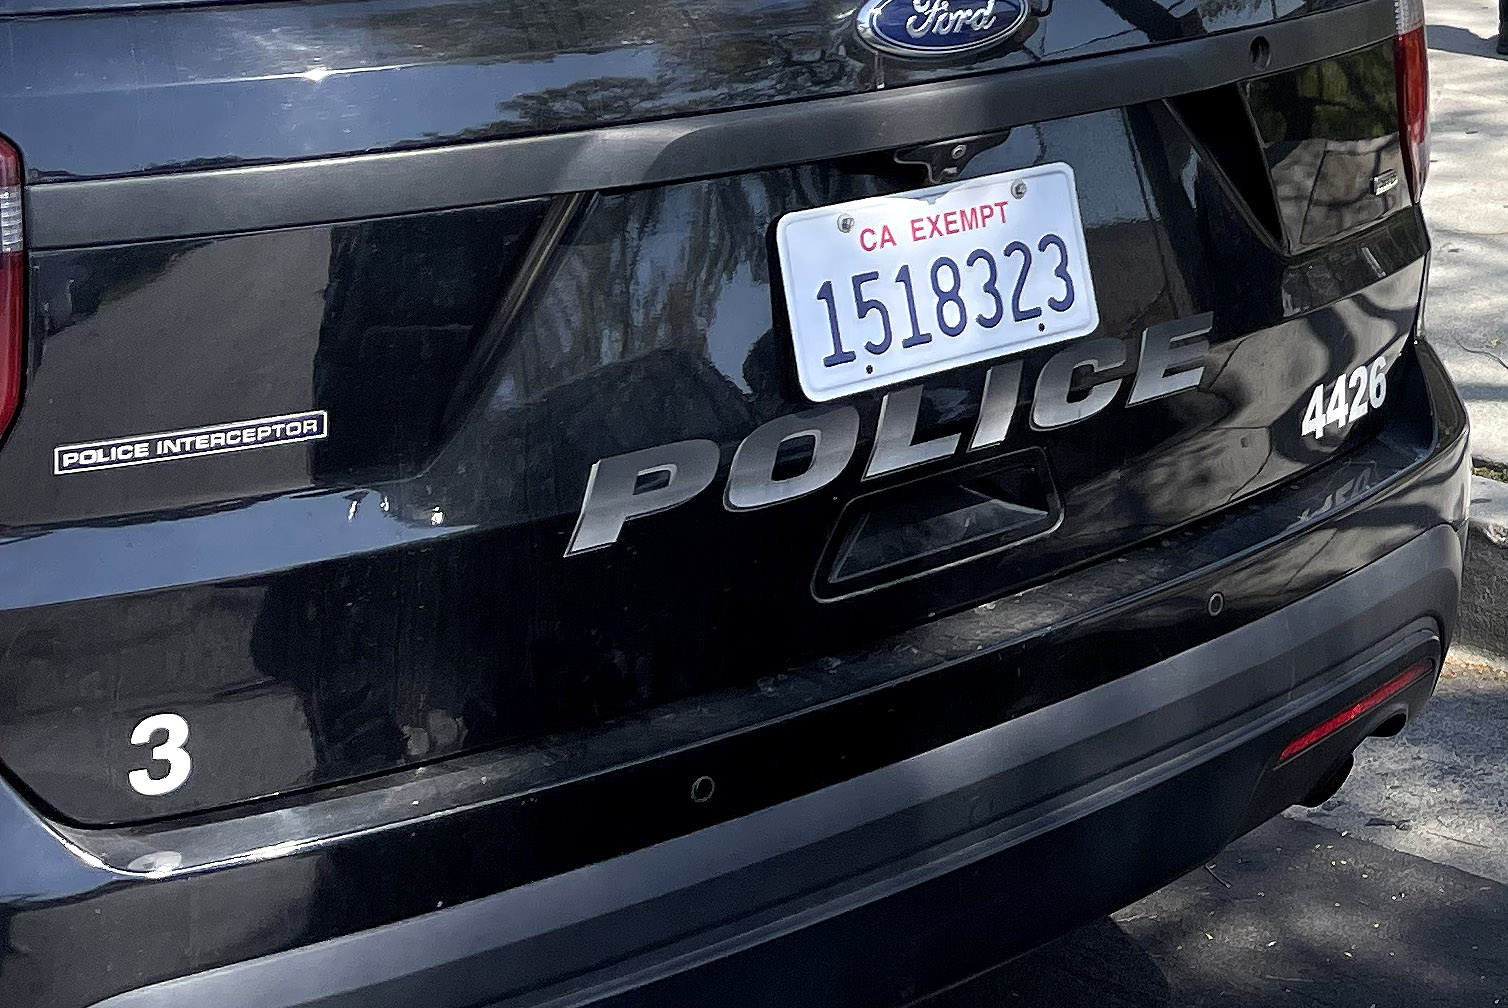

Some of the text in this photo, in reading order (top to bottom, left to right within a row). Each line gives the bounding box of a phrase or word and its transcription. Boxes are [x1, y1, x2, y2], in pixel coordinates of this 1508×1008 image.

[859, 200, 1010, 252] CA EXEMPT
[816, 233, 1076, 368] 1518323
[564, 311, 1214, 558] POLICE
[1301, 356, 1387, 440] 4426
[62, 419, 319, 468] POLICE INTERCEPTOR
[127, 712, 192, 796] 3
